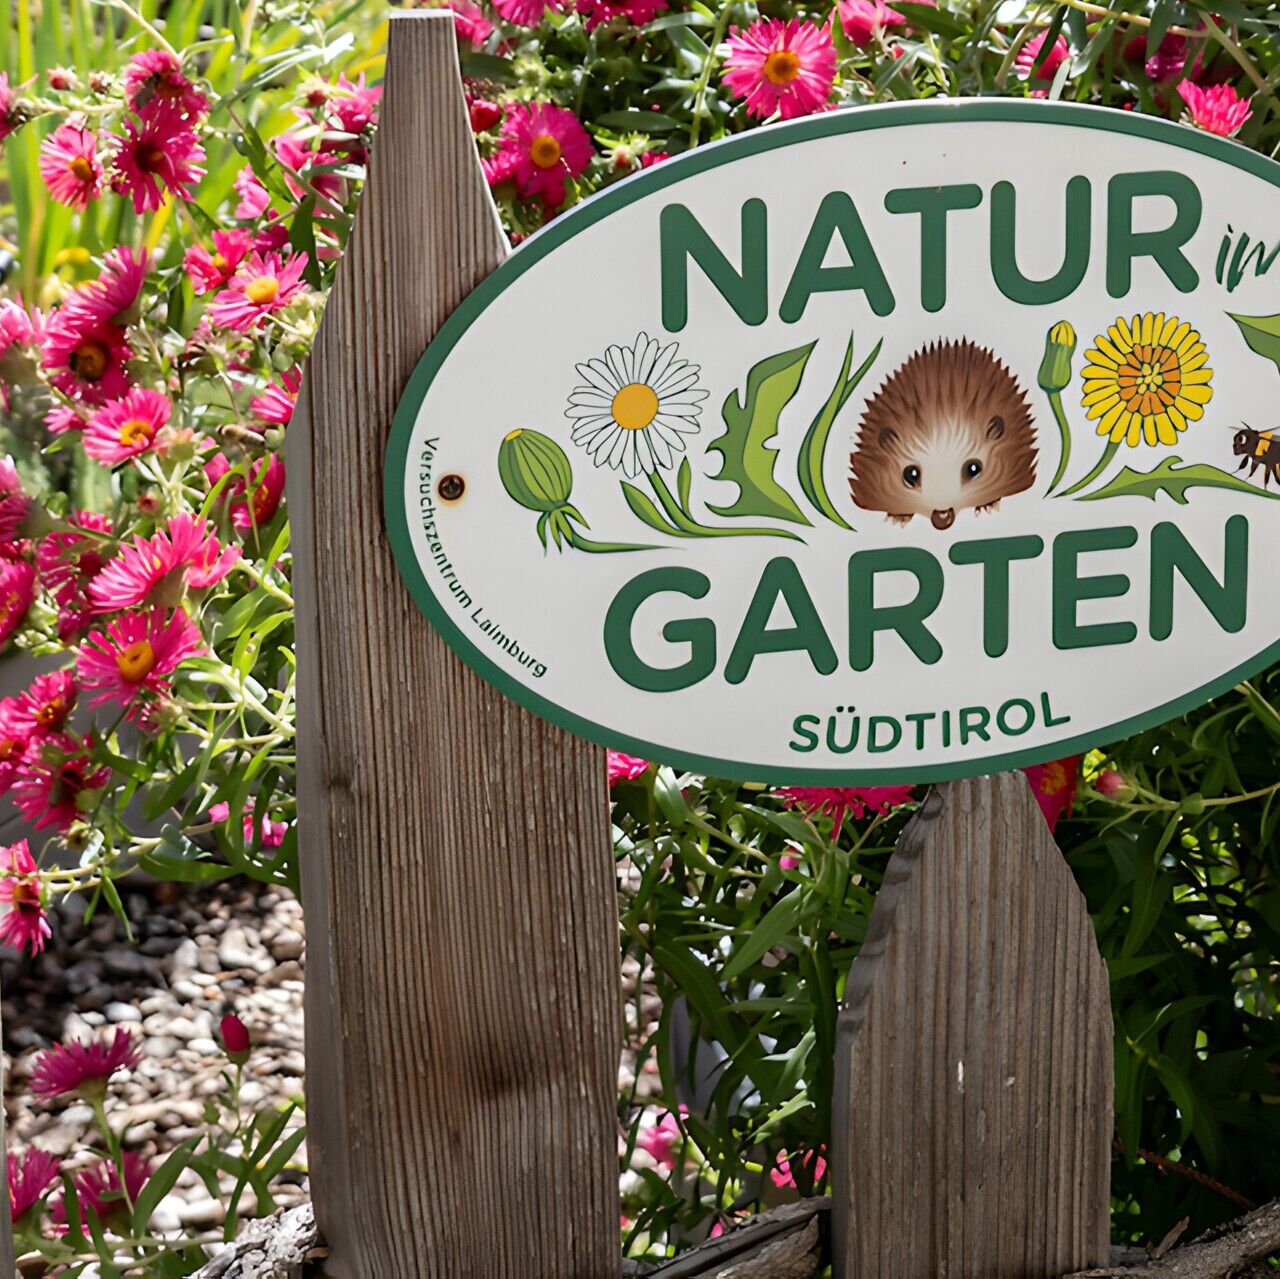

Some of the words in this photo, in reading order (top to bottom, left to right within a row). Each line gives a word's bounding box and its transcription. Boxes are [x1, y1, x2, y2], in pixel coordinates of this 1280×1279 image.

[658, 169, 1204, 333] NATUR
[419, 436, 472, 609] Versuchszentrum
[602, 514, 1250, 693] GARTEN
[788, 690, 1072, 756] SÜDTIROL
